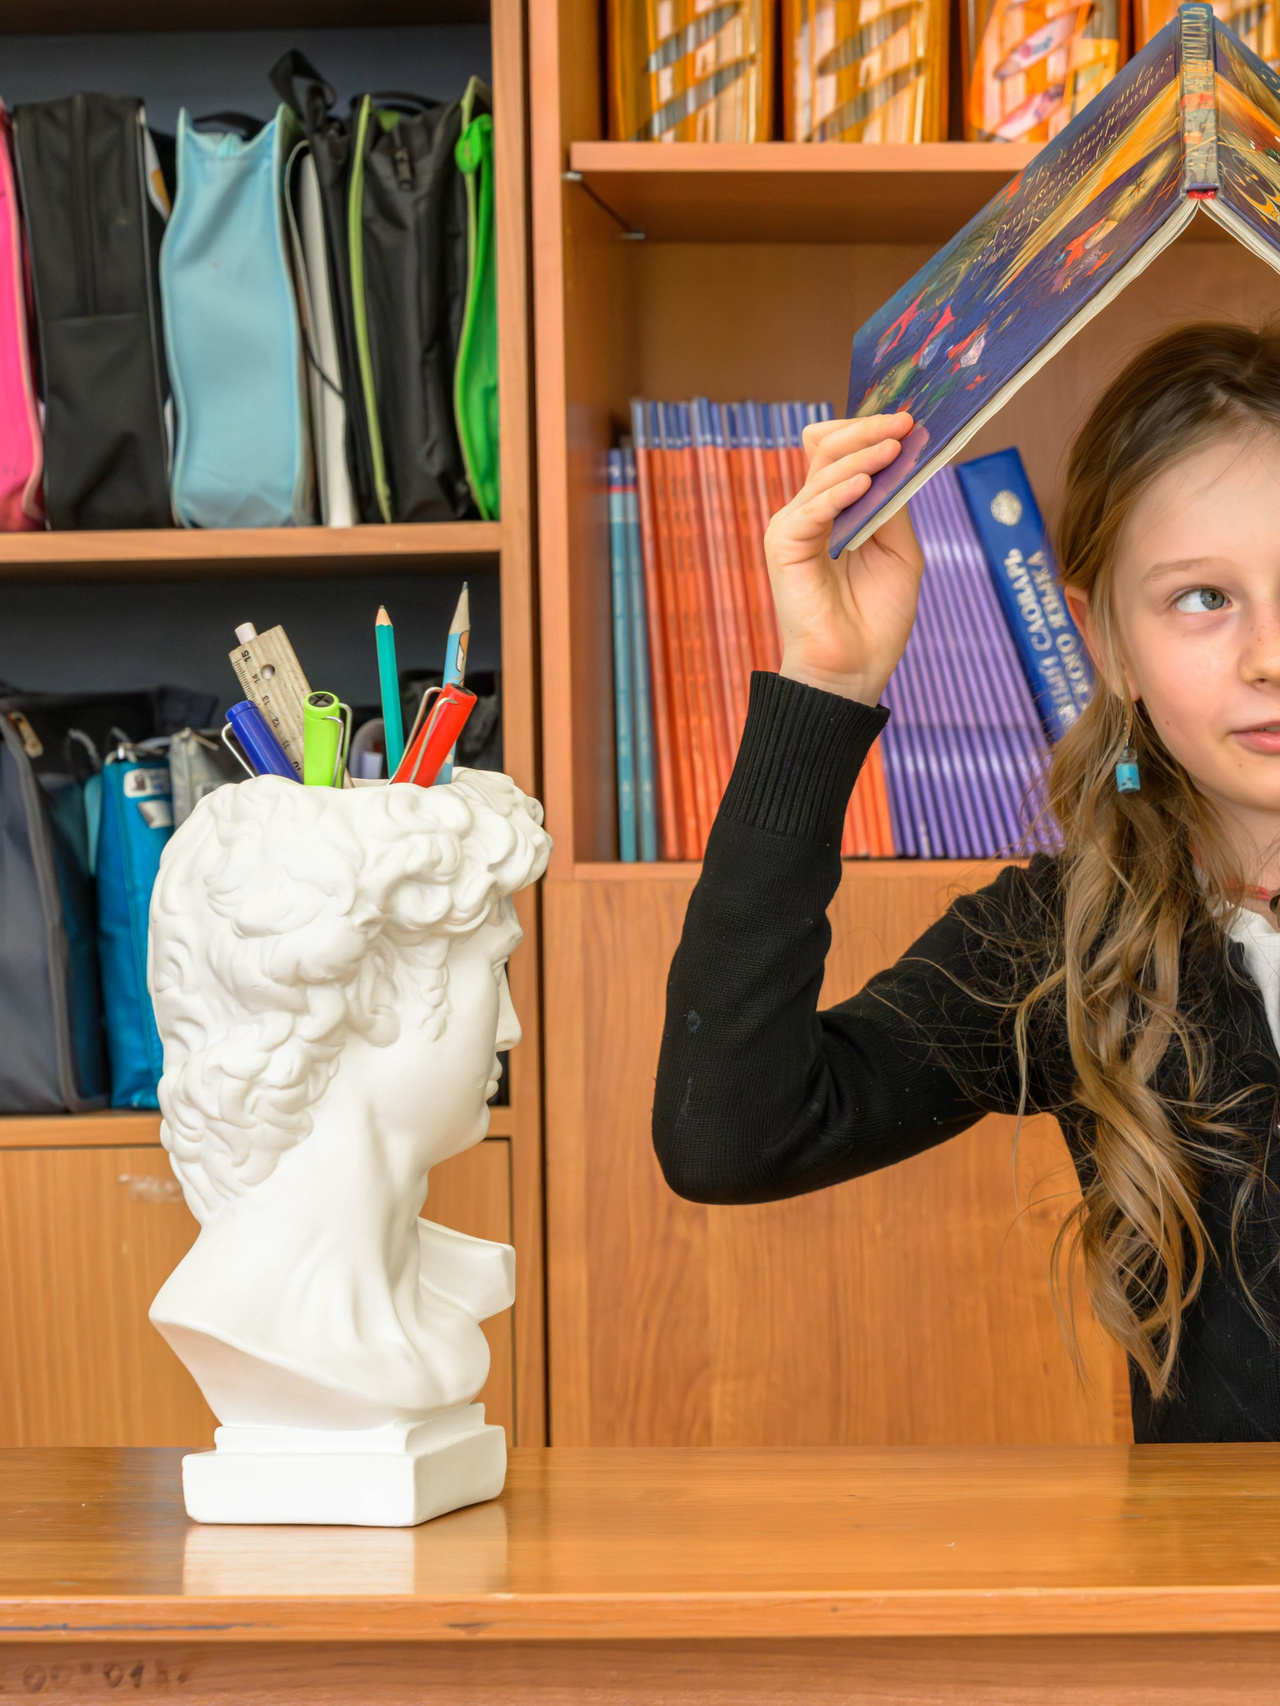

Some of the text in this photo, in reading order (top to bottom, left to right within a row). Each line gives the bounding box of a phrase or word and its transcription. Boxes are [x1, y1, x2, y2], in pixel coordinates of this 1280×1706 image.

[241, 649, 252, 662] 15
[252, 673, 261, 684] 14
[261, 695, 271, 706] 13
[272, 717, 281, 729] 12
